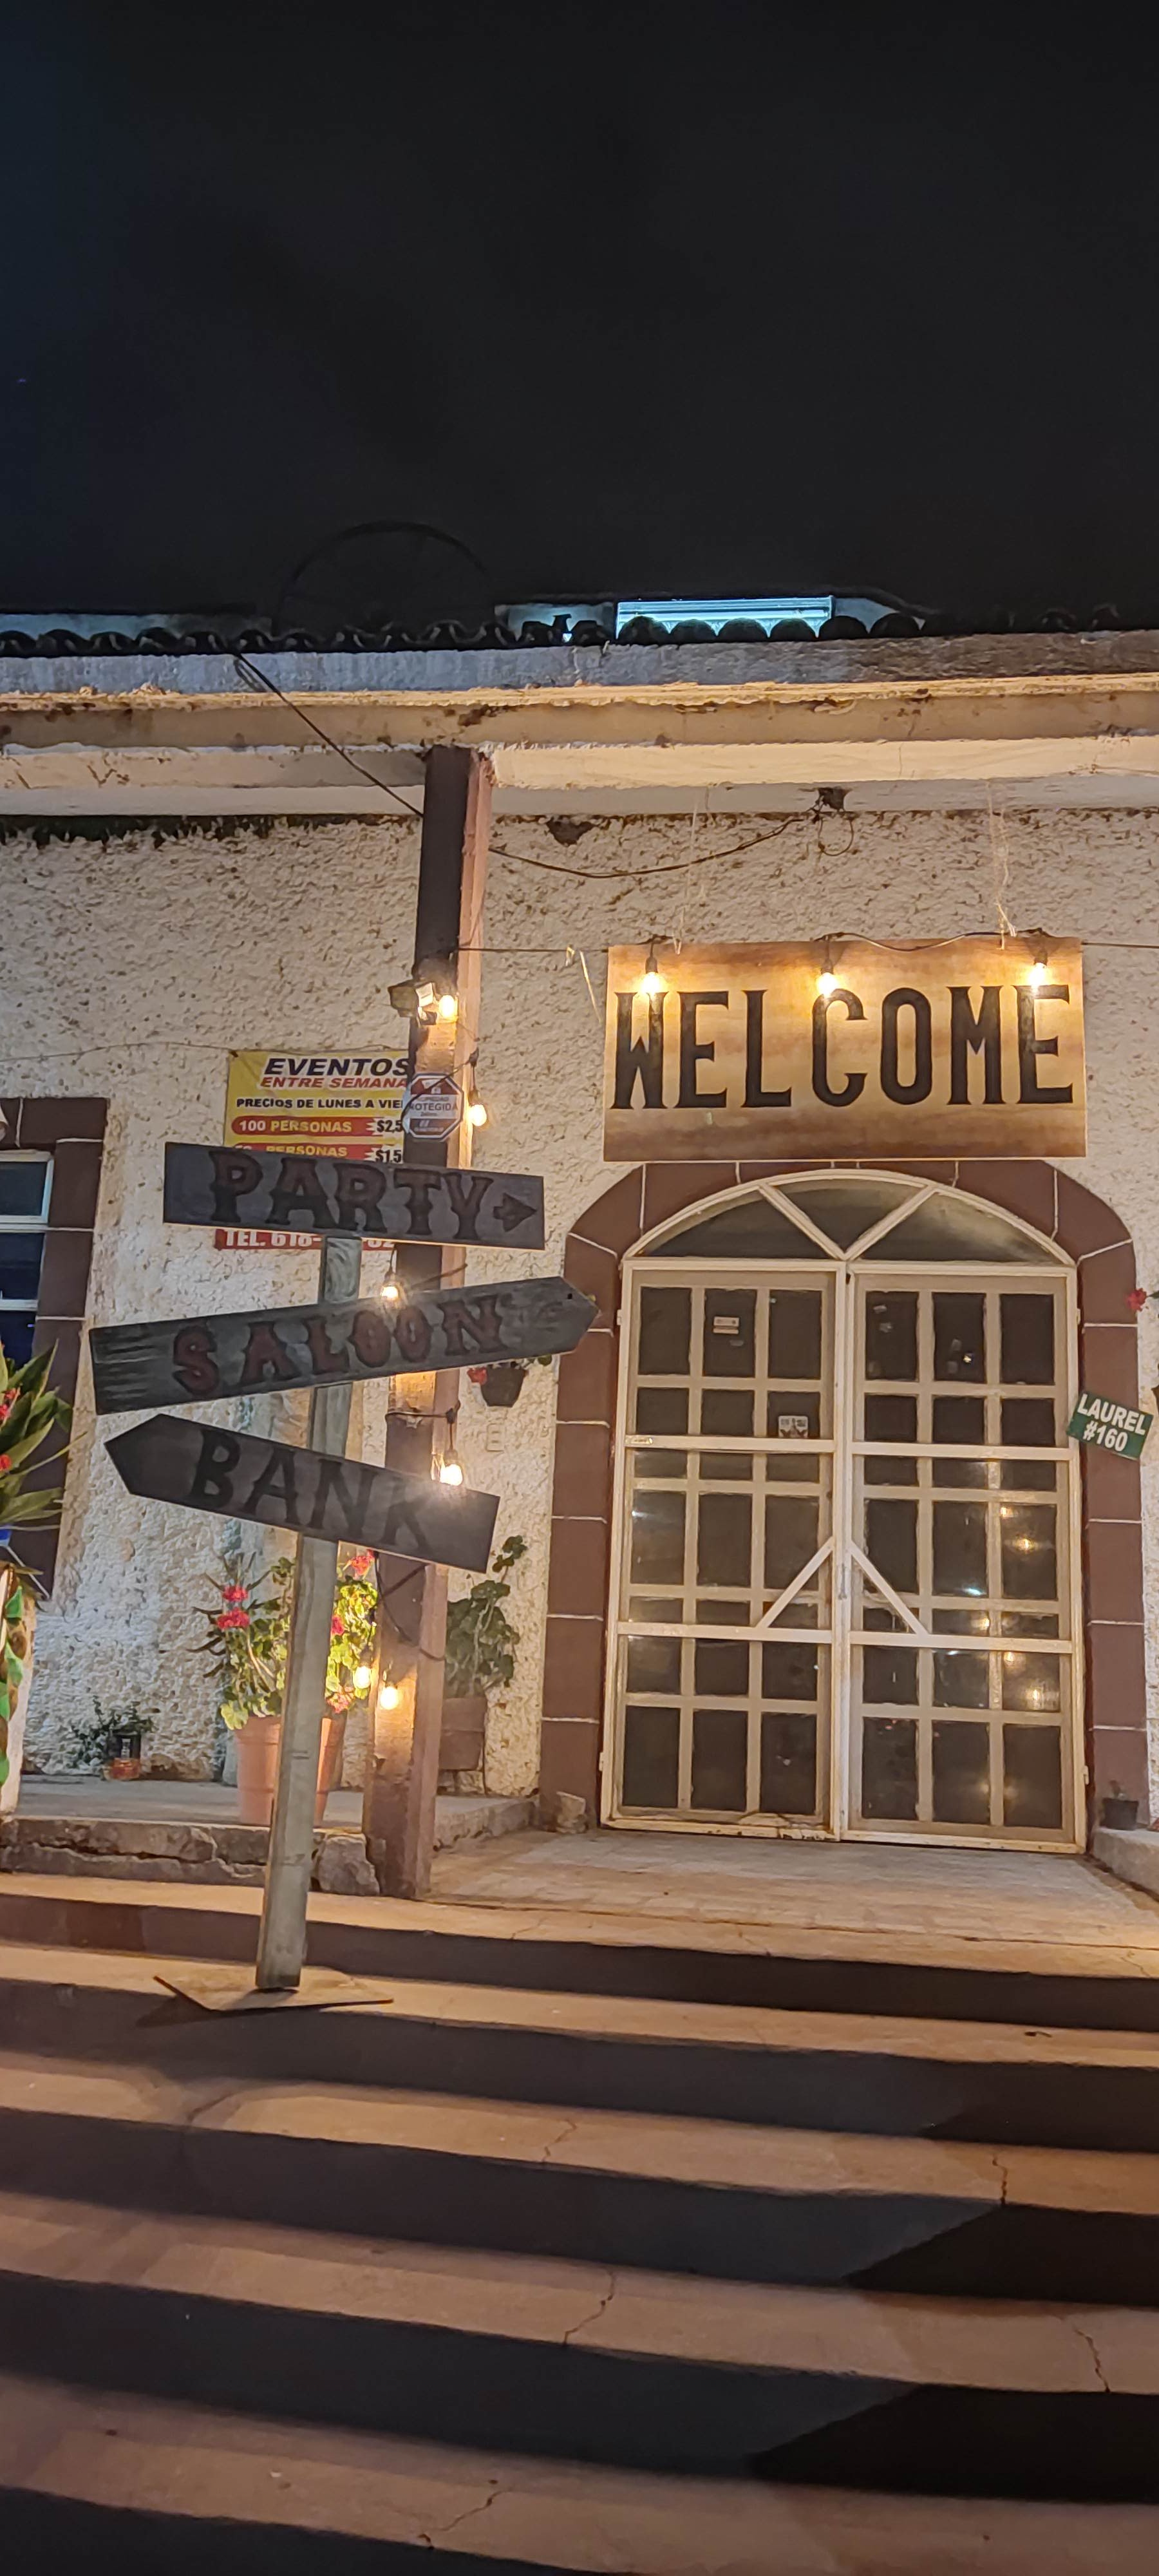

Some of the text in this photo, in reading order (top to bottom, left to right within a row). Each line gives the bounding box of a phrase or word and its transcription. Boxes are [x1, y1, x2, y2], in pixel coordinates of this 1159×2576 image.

[610, 984, 1073, 1110] WELCOME
[264, 1058, 409, 1075] EVENTOS
[260, 1077, 407, 1088] ENTRE SEMANA
[236, 1099, 402, 1108] PRECIOS DE LUNES A VIE
[240, 1121, 265, 1131] 100
[270, 1121, 352, 1132] PERSONAS
[266, 1146, 348, 1157] PERSONAS
[209, 1150, 493, 1240] PARTY
[225, 1230, 266, 1247] TEL.
[172, 1294, 509, 1396] SALOON
[1077, 1393, 1145, 1435] LAUREL
[1082, 1421, 1128, 1452] #160
[186, 1428, 435, 1555] BANK
